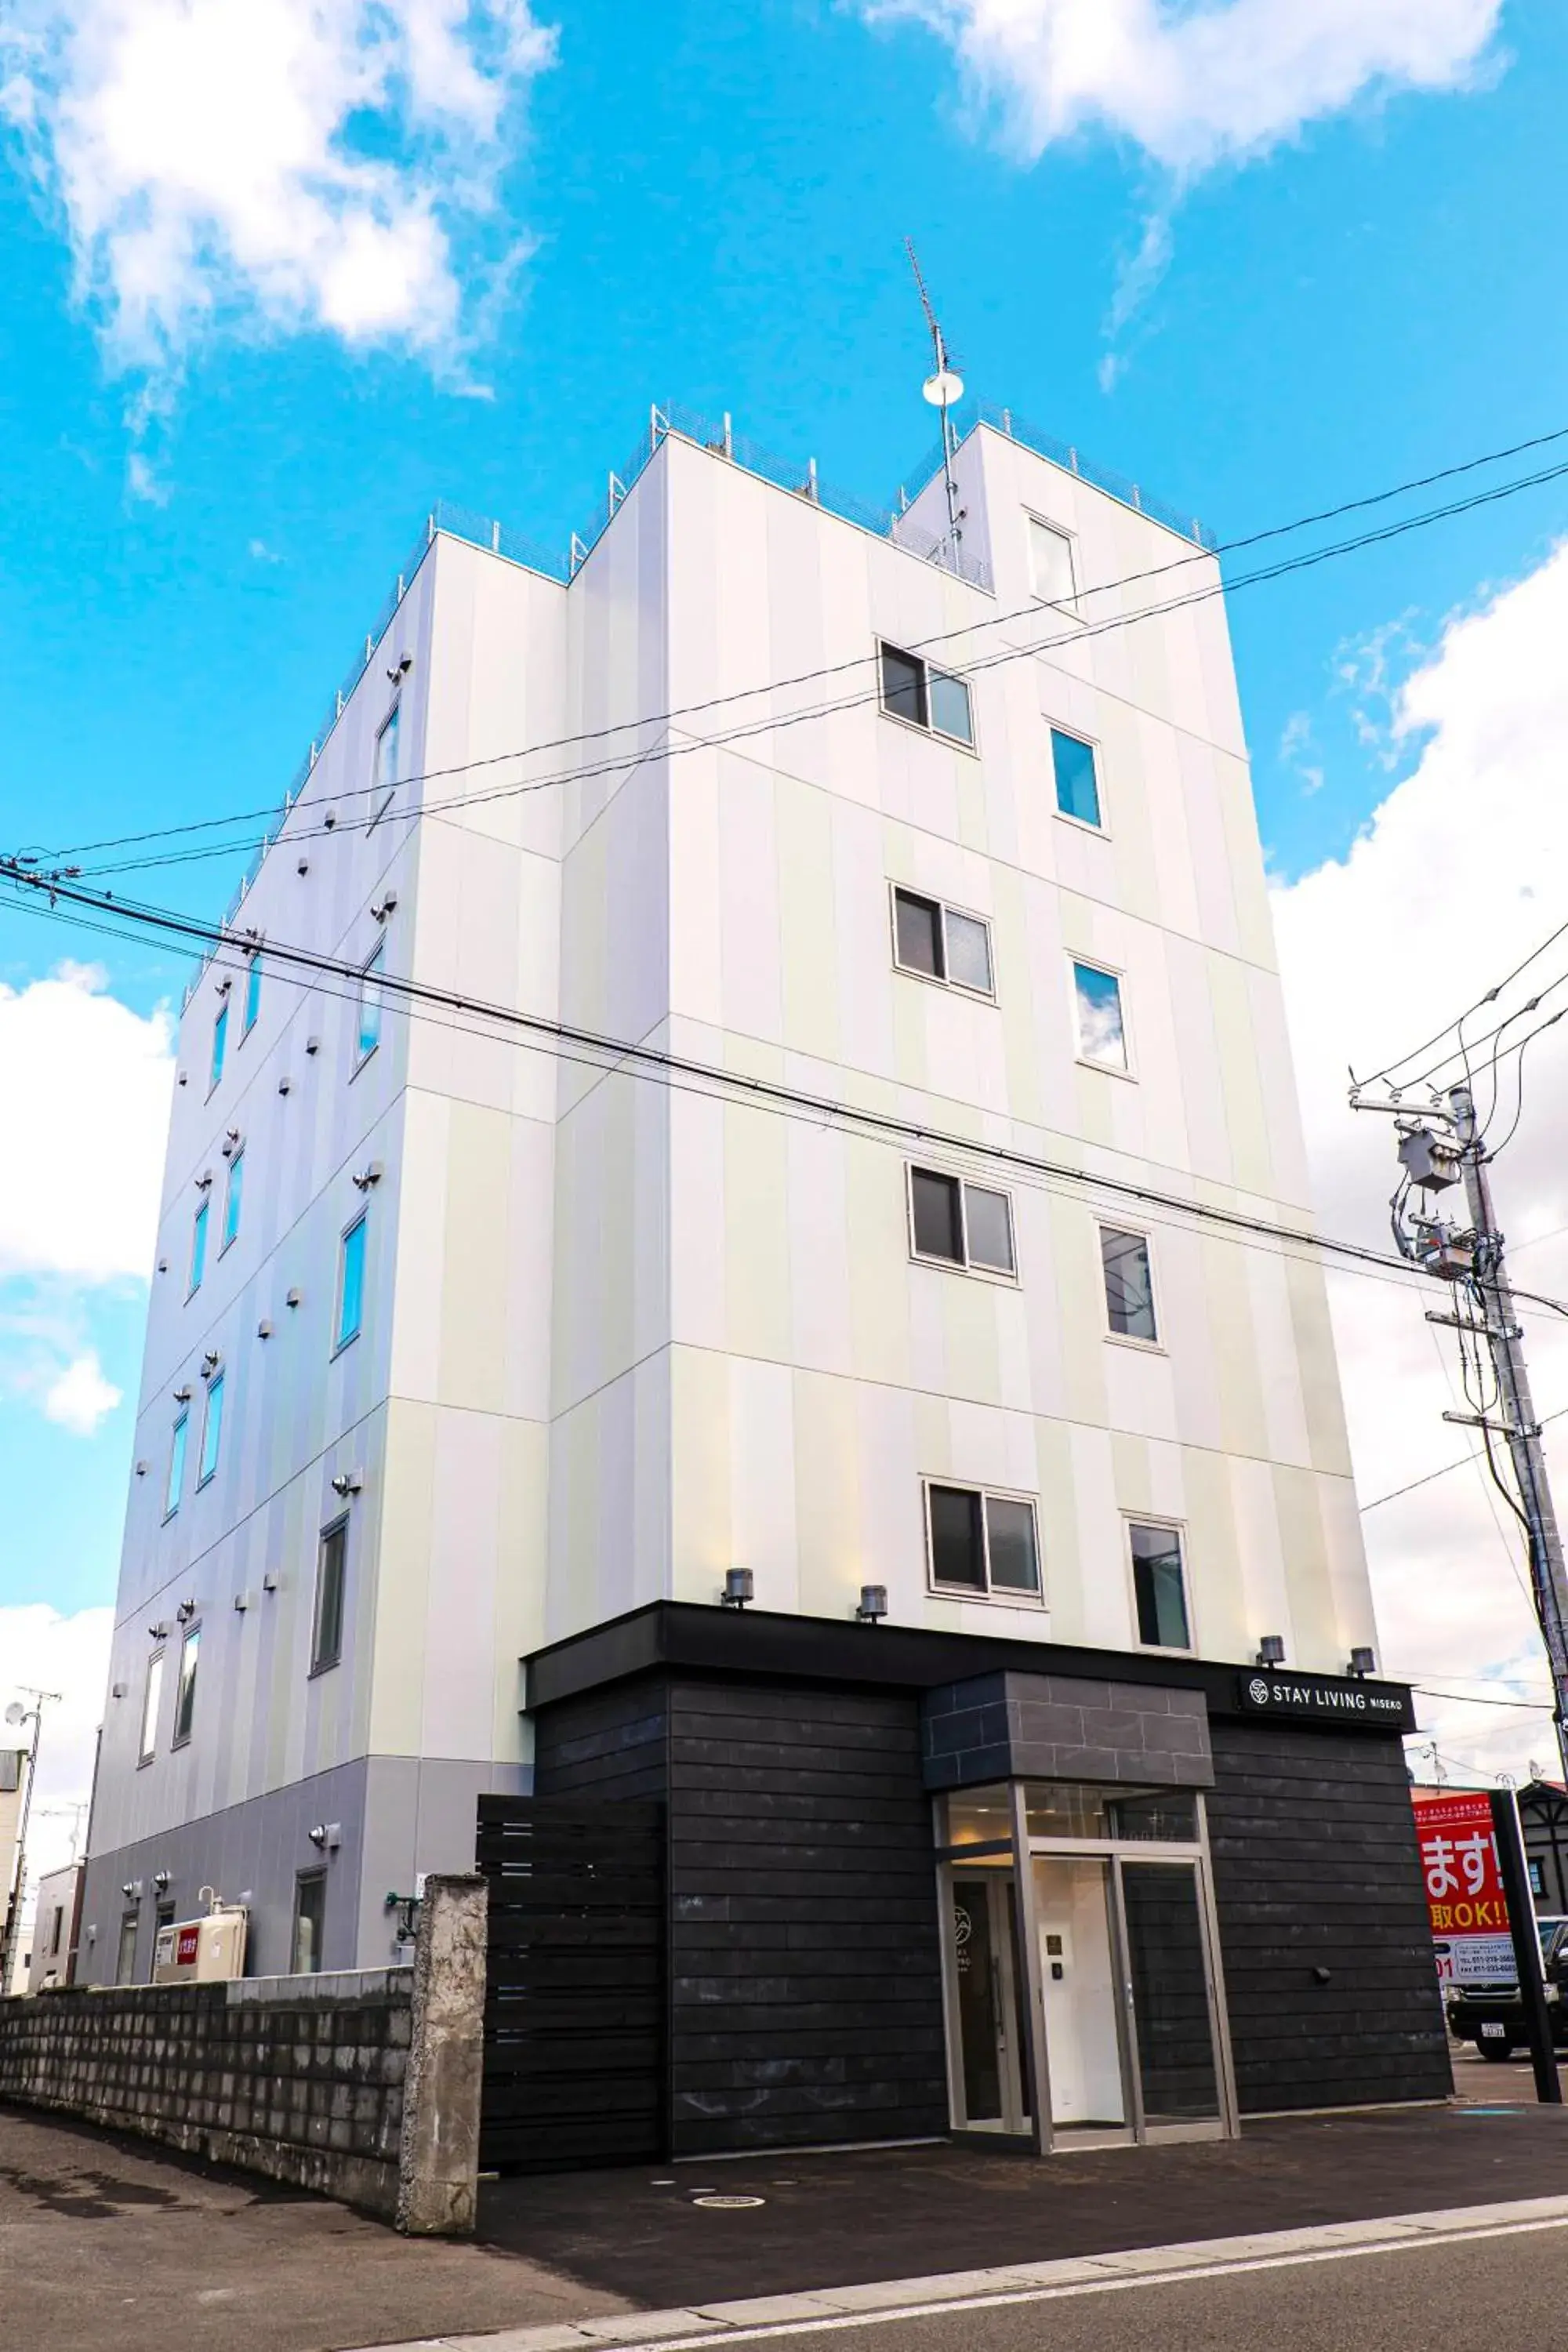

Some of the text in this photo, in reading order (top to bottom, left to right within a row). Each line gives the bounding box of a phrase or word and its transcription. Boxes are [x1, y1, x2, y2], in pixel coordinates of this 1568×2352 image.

[1273, 1685, 1403, 1710] STAY LIVING NISEKO
